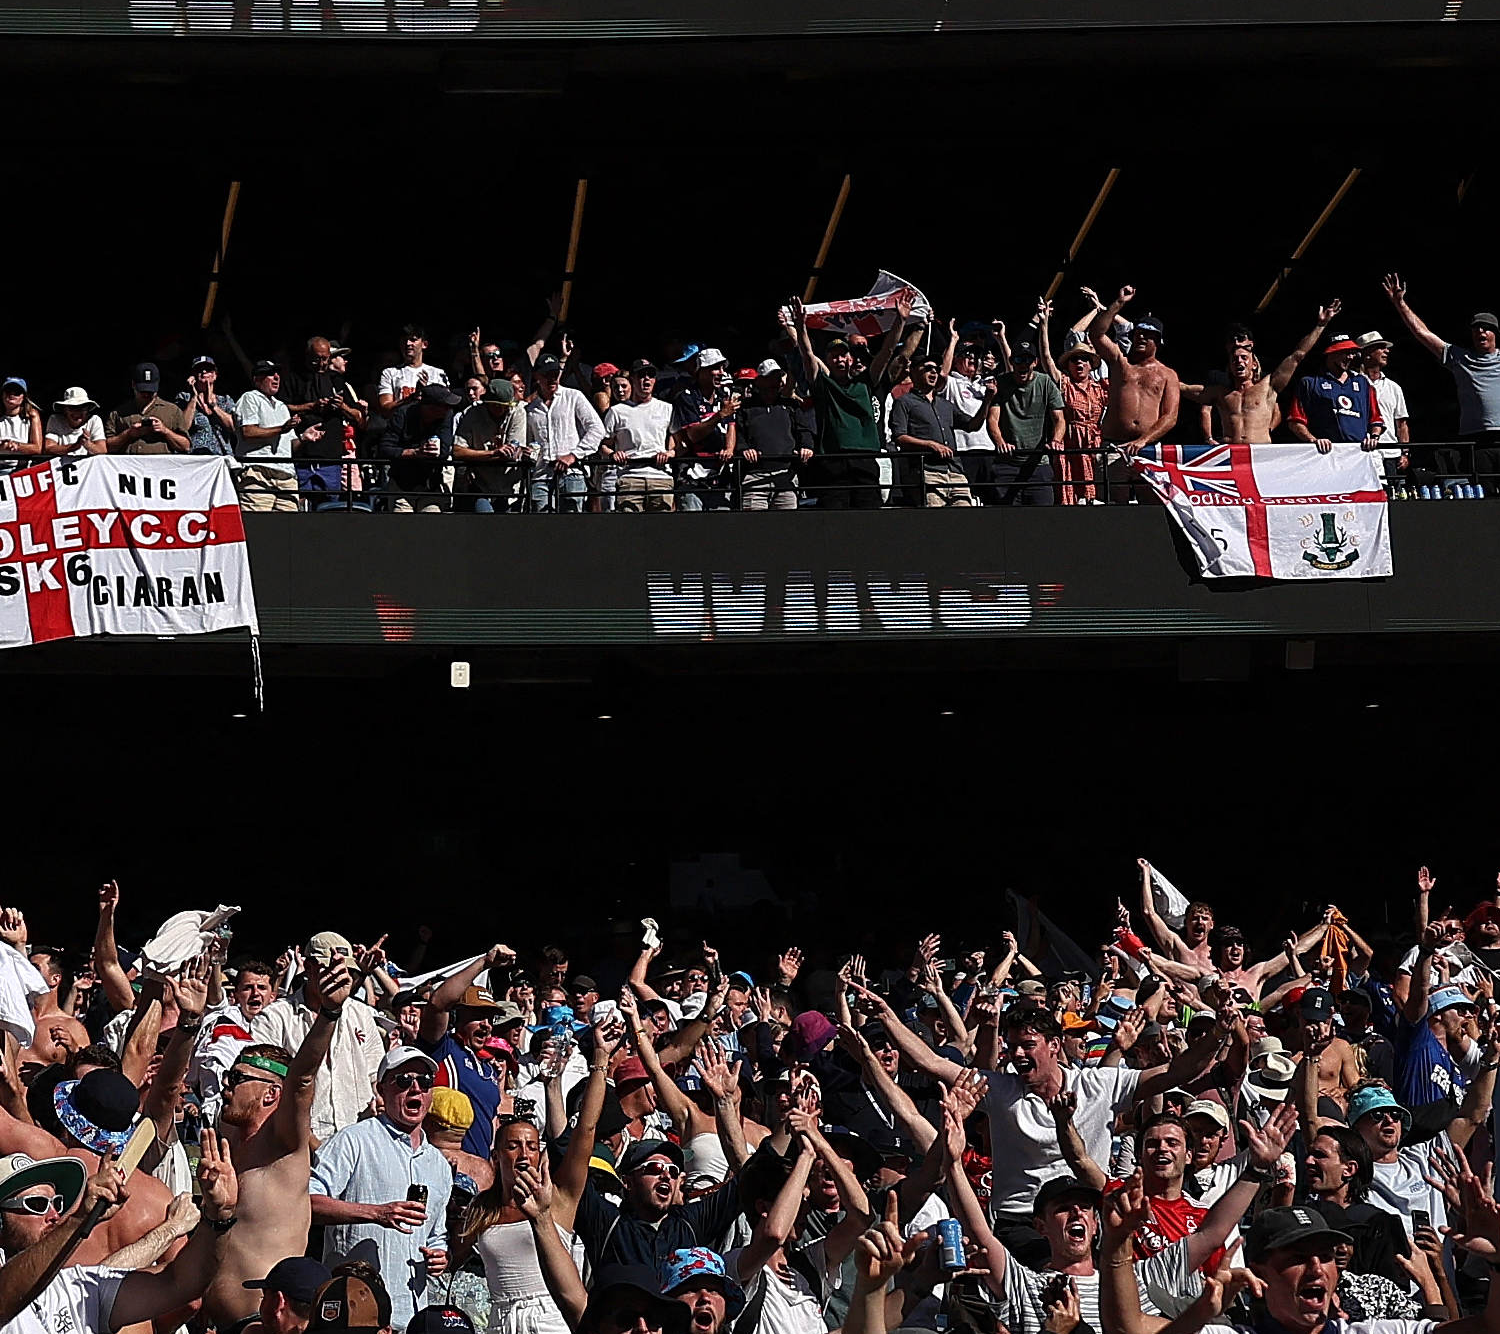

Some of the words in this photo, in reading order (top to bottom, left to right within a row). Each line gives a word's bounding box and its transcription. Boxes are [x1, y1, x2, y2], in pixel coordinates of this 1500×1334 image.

[118, 472, 177, 501] NIC
[1325, 493, 1353, 503] CC
[130, 512, 217, 545] C.C.
[93, 571, 226, 608] CIARAN
